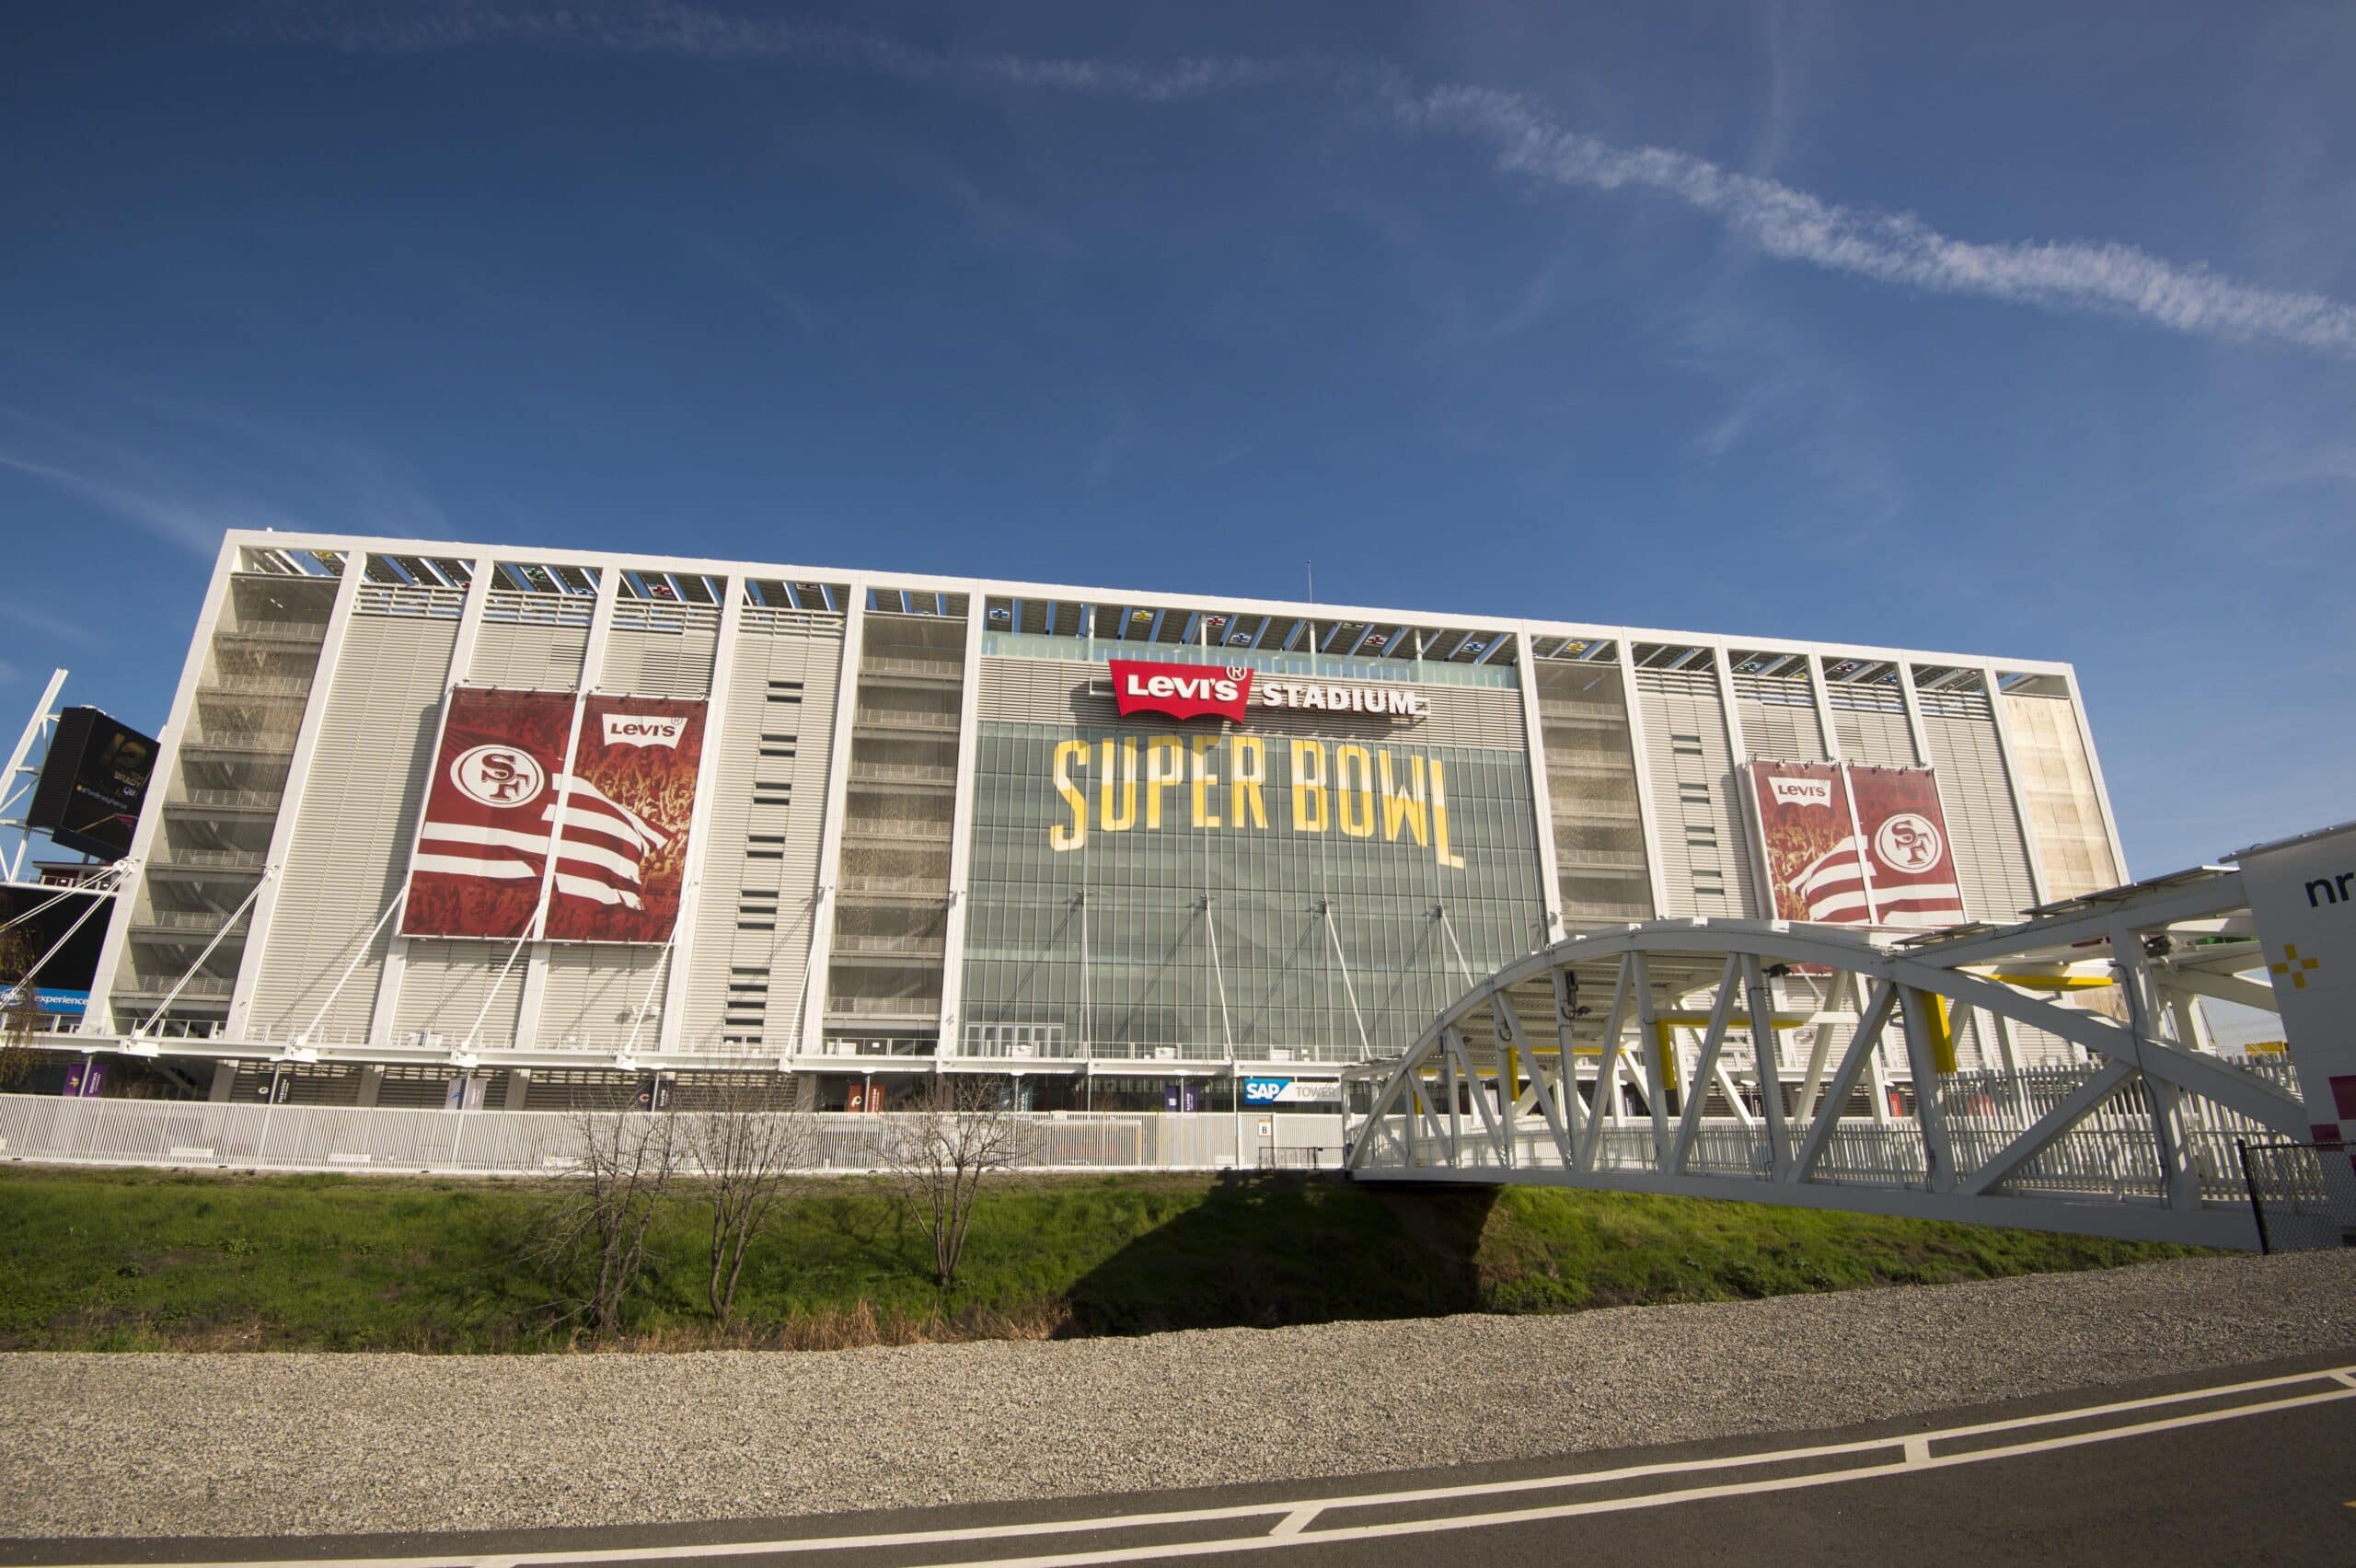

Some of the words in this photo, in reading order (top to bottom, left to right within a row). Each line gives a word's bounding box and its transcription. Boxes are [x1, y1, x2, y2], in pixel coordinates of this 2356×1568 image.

[1261, 683, 1416, 715] STADIUM
[1049, 735, 1269, 852] SUPER
[1291, 739, 1465, 870] BOWL
[34, 994, 89, 1005] experience
[1246, 1083, 1280, 1100] SAP
[1295, 1086, 1338, 1098] TOWER
